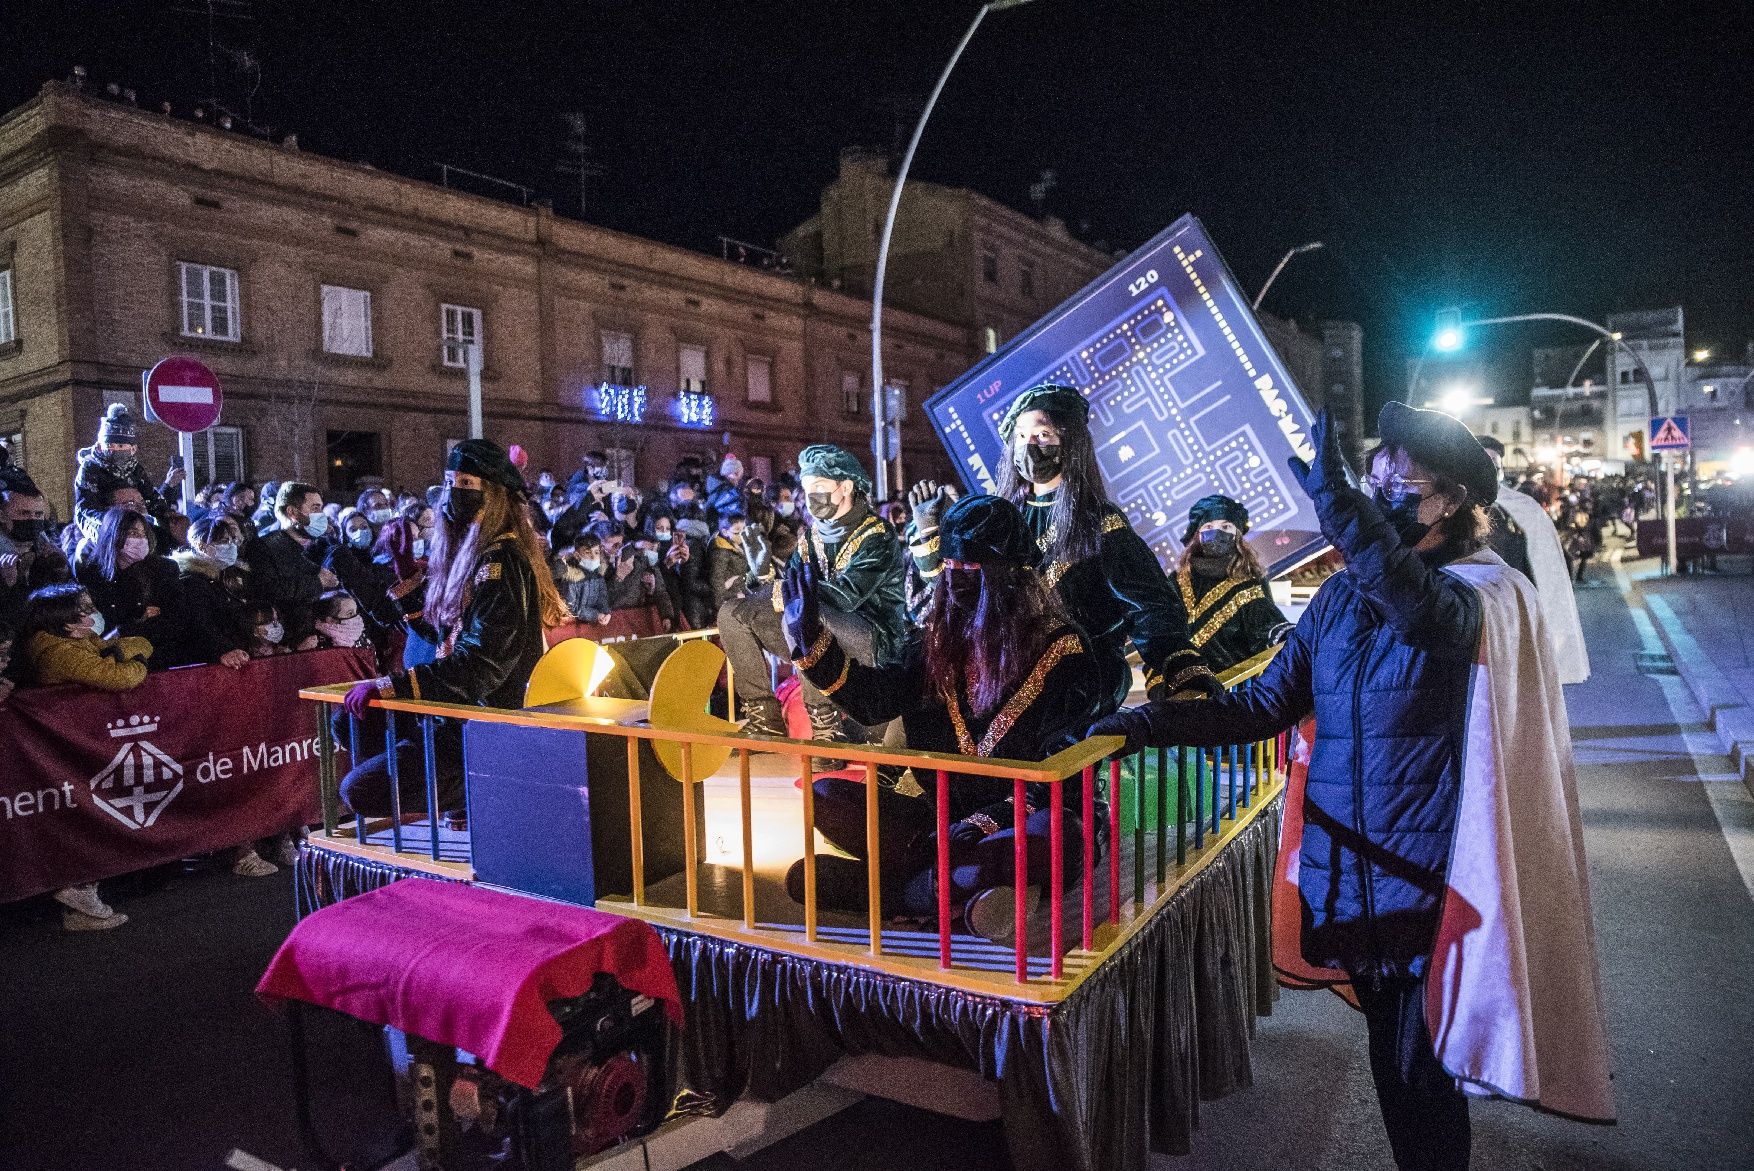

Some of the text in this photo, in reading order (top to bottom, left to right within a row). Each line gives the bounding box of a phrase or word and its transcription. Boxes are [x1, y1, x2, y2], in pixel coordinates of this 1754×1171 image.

[1128, 269, 1159, 297] 120
[976, 379, 1002, 405] 1UP
[196, 751, 233, 784] de
